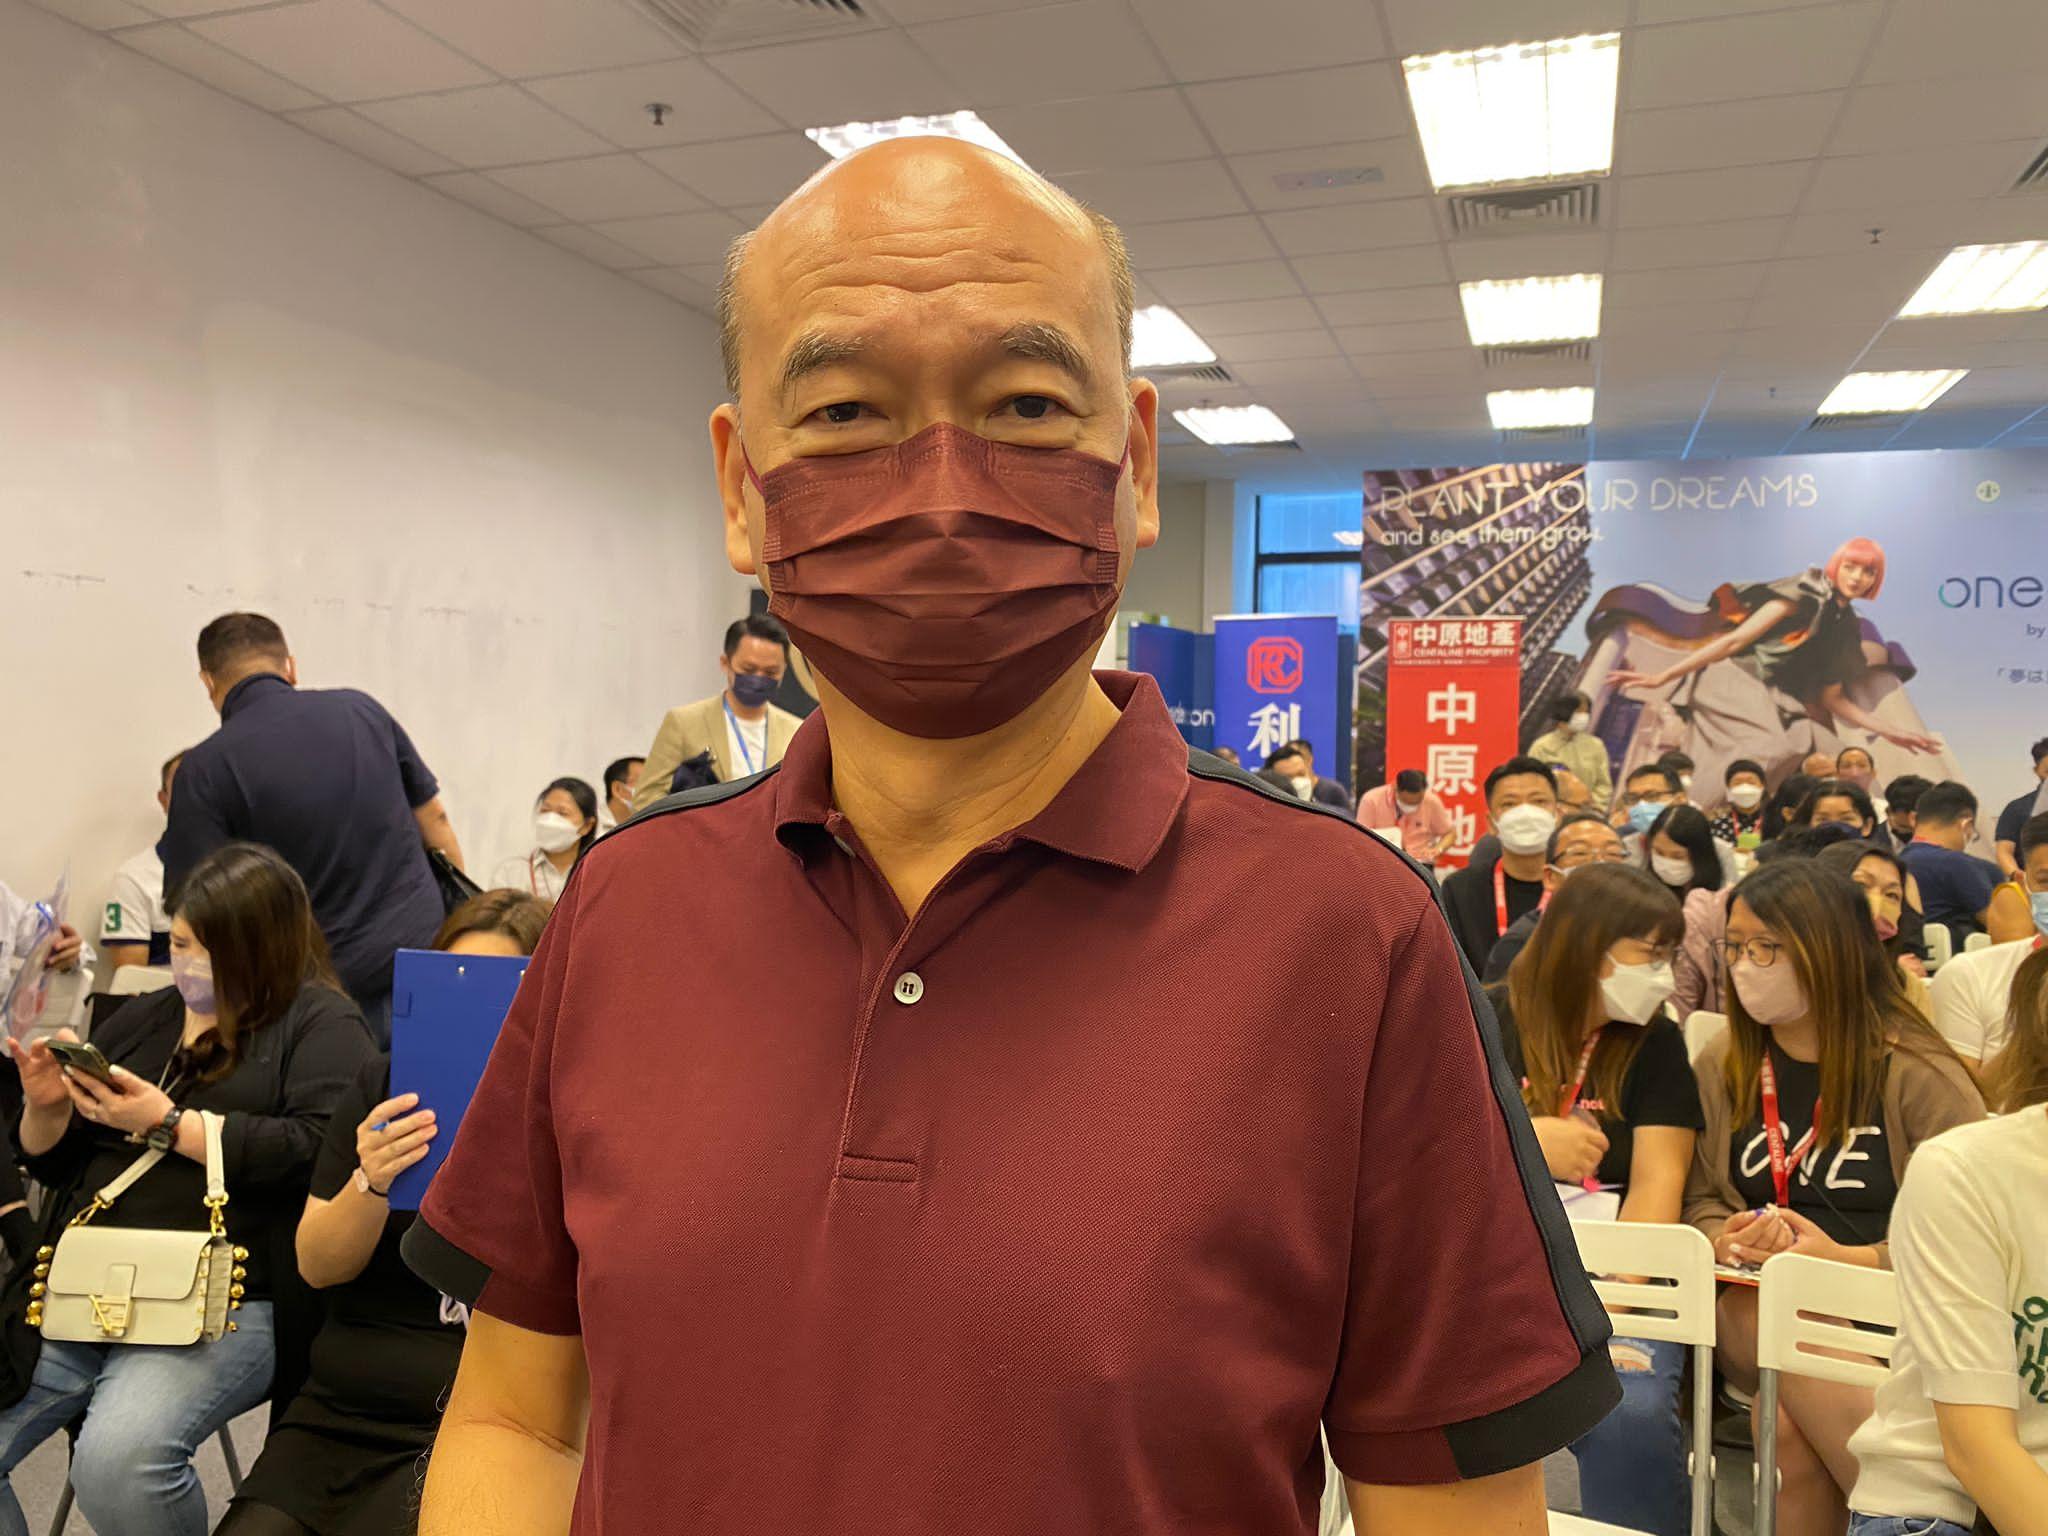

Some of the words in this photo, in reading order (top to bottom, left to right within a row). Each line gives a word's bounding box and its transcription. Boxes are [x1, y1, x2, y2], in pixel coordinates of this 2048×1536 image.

[1380, 482, 1518, 519] PLANT
[1523, 477, 1639, 514] YOUR
[1650, 474, 1819, 511] DREAMS
[1381, 525, 1423, 546] and
[1430, 529, 1470, 545] see
[1479, 524, 1536, 544] them
[1938, 576, 2044, 609] one
[1413, 622, 1516, 647] 中原地產
[2026, 624, 2046, 638] by
[1413, 647, 1463, 657] CENTALINE
[1466, 647, 1515, 657] PROPERTY
[1998, 668, 2048, 683] 「夢は
[1247, 702, 1302, 773] 利
[1427, 683, 1478, 877] 中原地
[105, 902, 122, 932] 3
